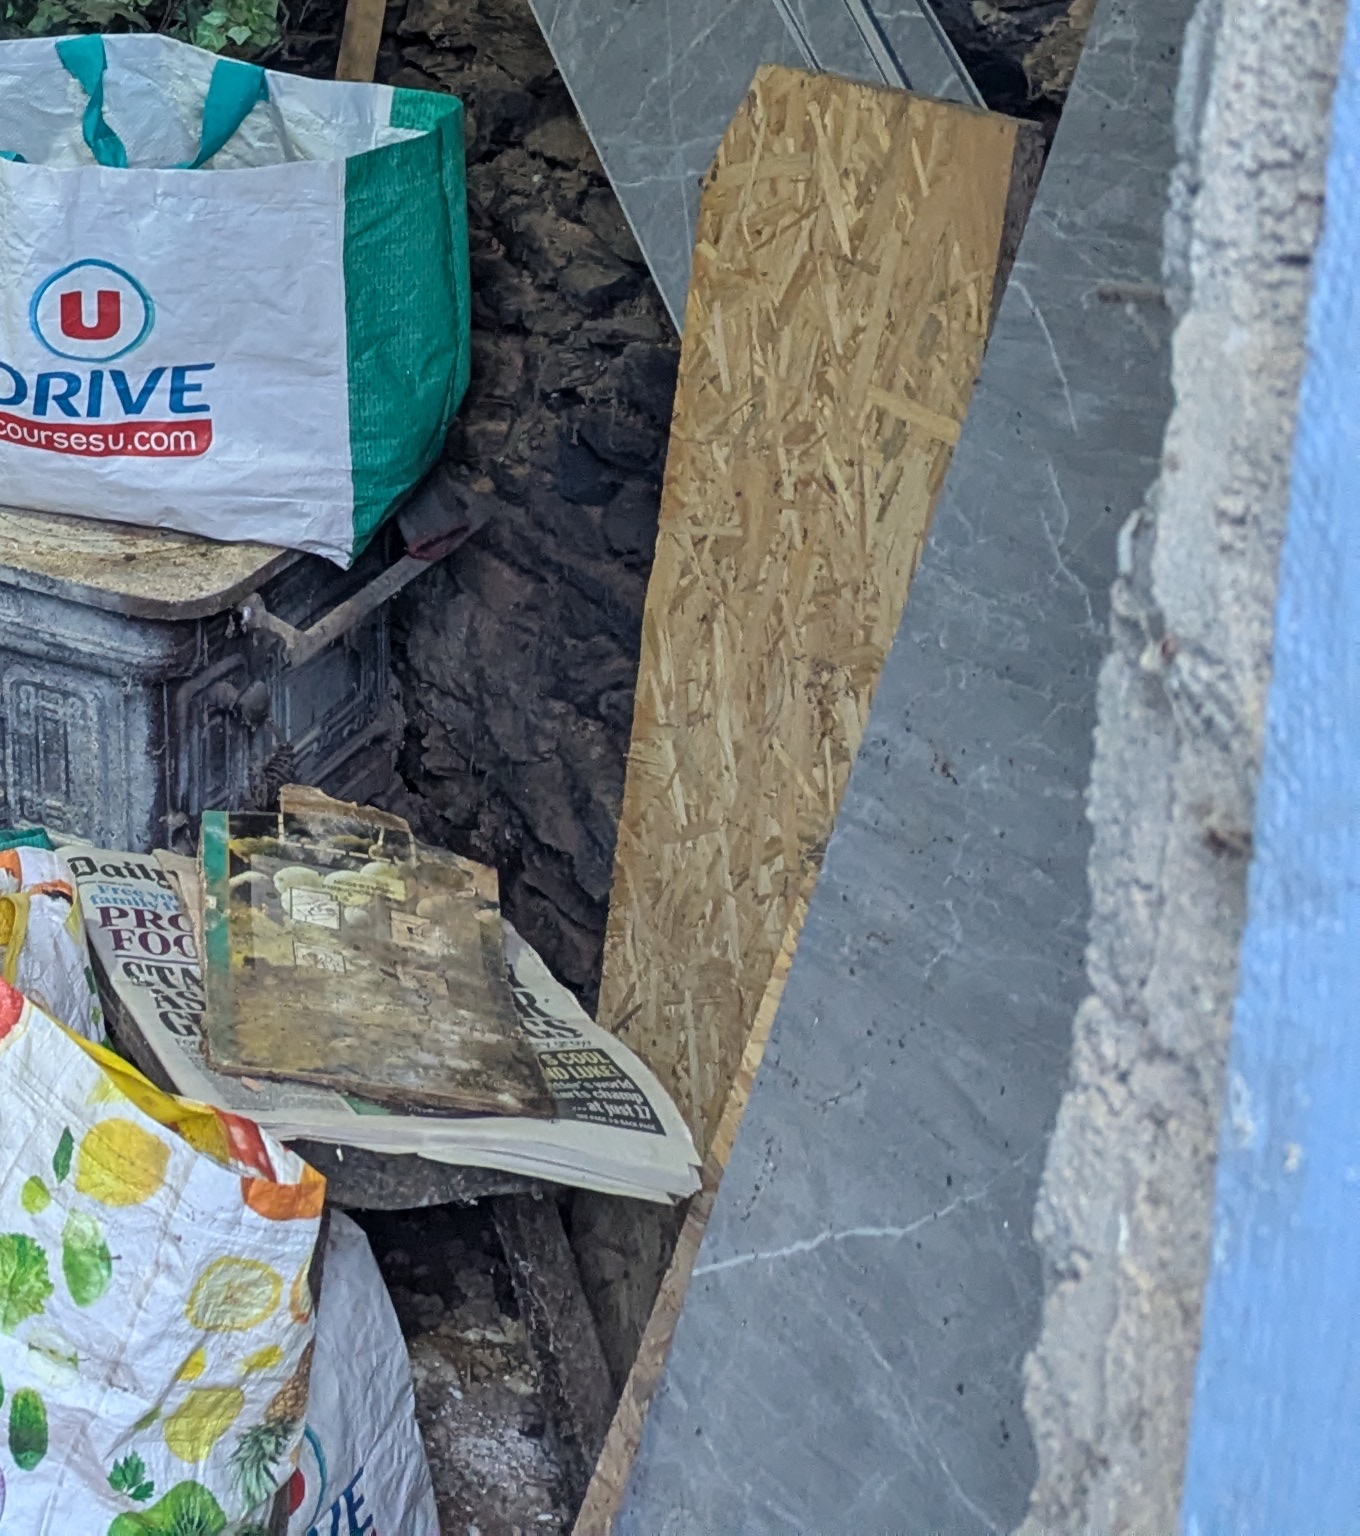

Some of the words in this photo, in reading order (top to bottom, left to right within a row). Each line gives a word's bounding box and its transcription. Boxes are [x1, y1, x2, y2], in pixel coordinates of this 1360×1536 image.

[60, 290, 121, 340] U
[67, 856, 179, 890] Daily
[556, 1051, 610, 1065] COOL
[592, 1089, 645, 1104] champ
